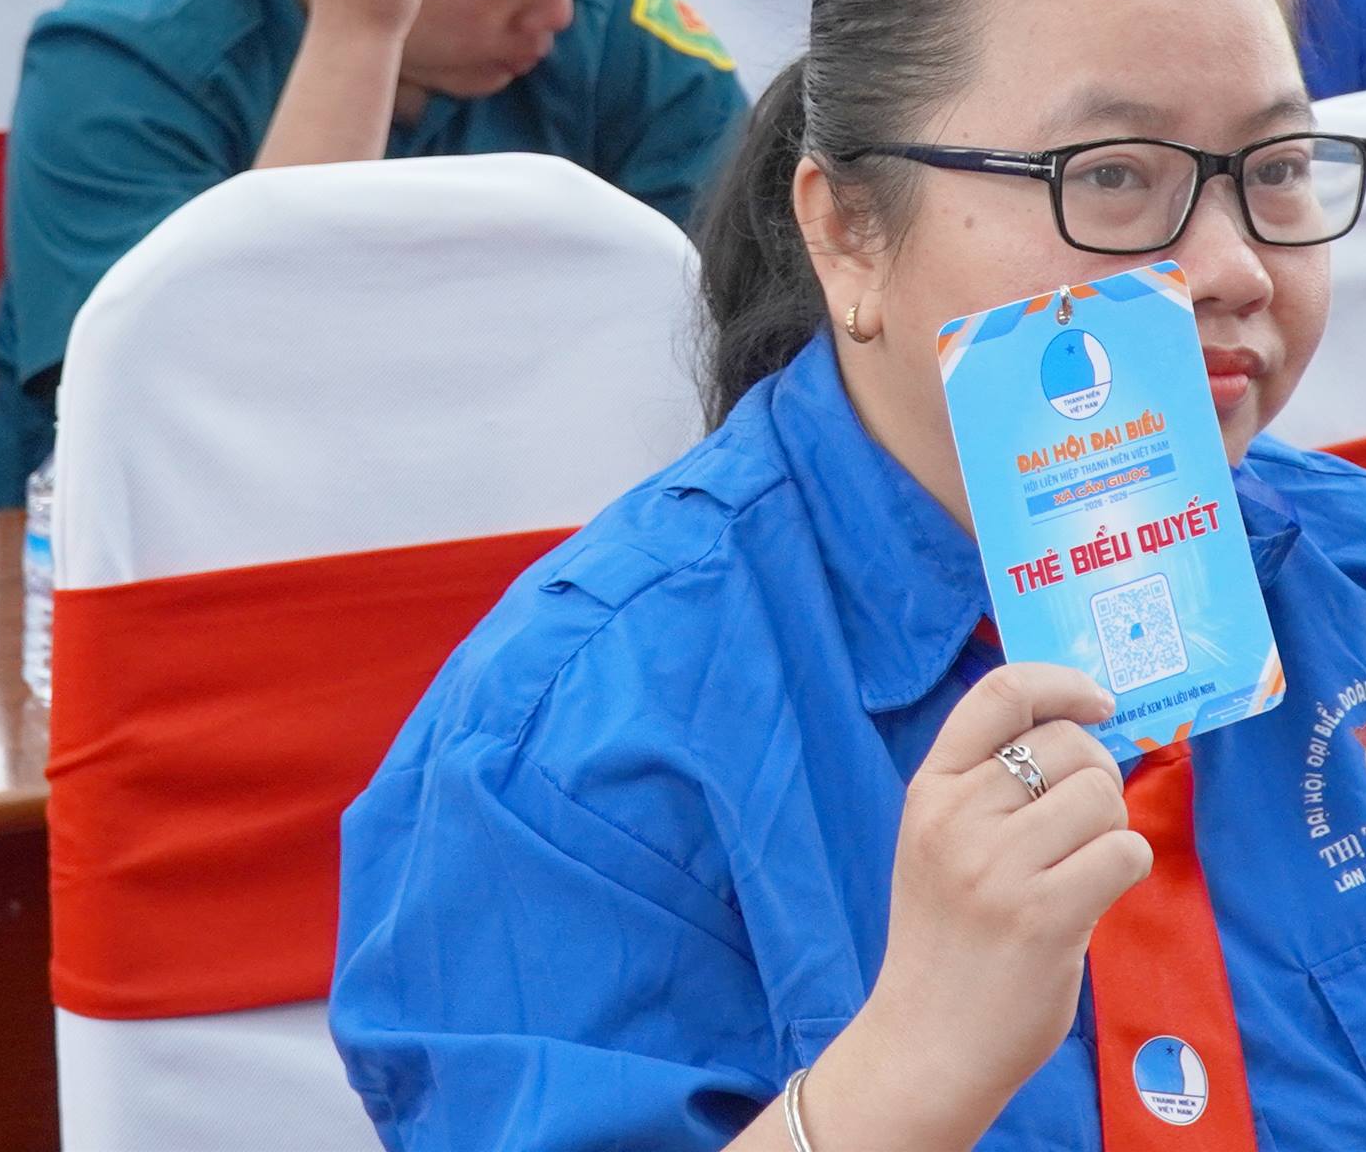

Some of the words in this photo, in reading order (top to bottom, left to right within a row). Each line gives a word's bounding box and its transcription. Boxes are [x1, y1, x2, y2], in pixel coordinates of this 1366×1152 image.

[1017, 447, 1050, 474] ĐẠI
[1053, 434, 1087, 462] HỘI
[1090, 425, 1123, 452] ĐẠI
[1081, 459, 1110, 477] THANH
[1151, 440, 1171, 453] NAM
[1007, 548, 1065, 595] THẺ
[1069, 524, 1134, 576] BIỂU
[1137, 495, 1221, 556] QUYẾT
